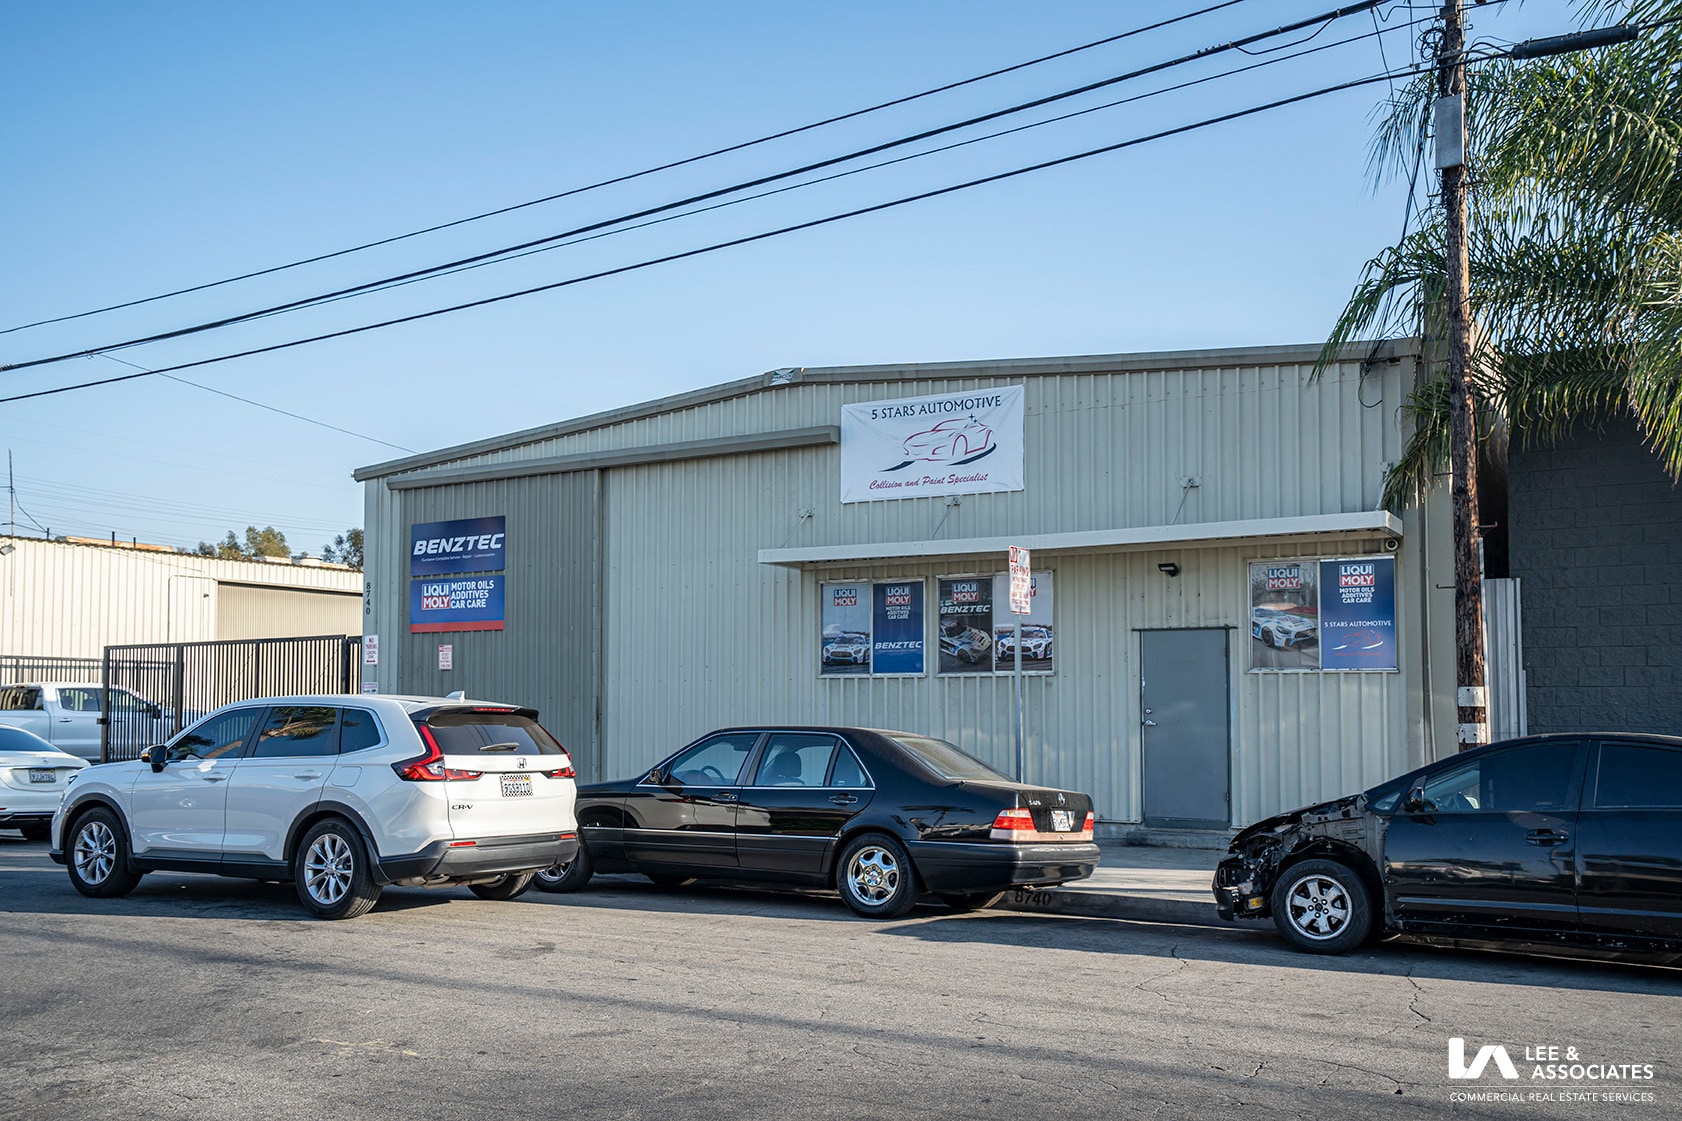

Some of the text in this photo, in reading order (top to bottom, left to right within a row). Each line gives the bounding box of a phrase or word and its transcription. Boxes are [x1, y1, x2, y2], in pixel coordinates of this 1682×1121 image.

[871, 395, 1001, 420] 5 STARS AUTOMOTIVE
[869, 472, 989, 490] Collision and Paint Specialist
[413, 533, 505, 556] BENZTEC
[1268, 568, 1298, 578] LIQUI
[1341, 565, 1372, 575] LIQUI
[451, 580, 494, 590] MOTOR OILS
[1268, 578, 1299, 588] MOLY
[1341, 575, 1373, 585] MOLY
[424, 584, 449, 596] LIQUI
[835, 589, 856, 597] LIQUI
[887, 587, 909, 595] LIQUI
[953, 584, 977, 592] LIQUI
[451, 590, 489, 600] ADDITIVES
[887, 595, 910, 604] MOLY
[953, 592, 978, 600] MOLY
[424, 596, 450, 608] MOLY
[450, 599, 487, 609] CAR CARE
[835, 598, 856, 606] MOLY
[940, 604, 990, 614] BENZTEC
[875, 641, 922, 650] BENZTEC
[1015, 890, 1052, 906] 8740
